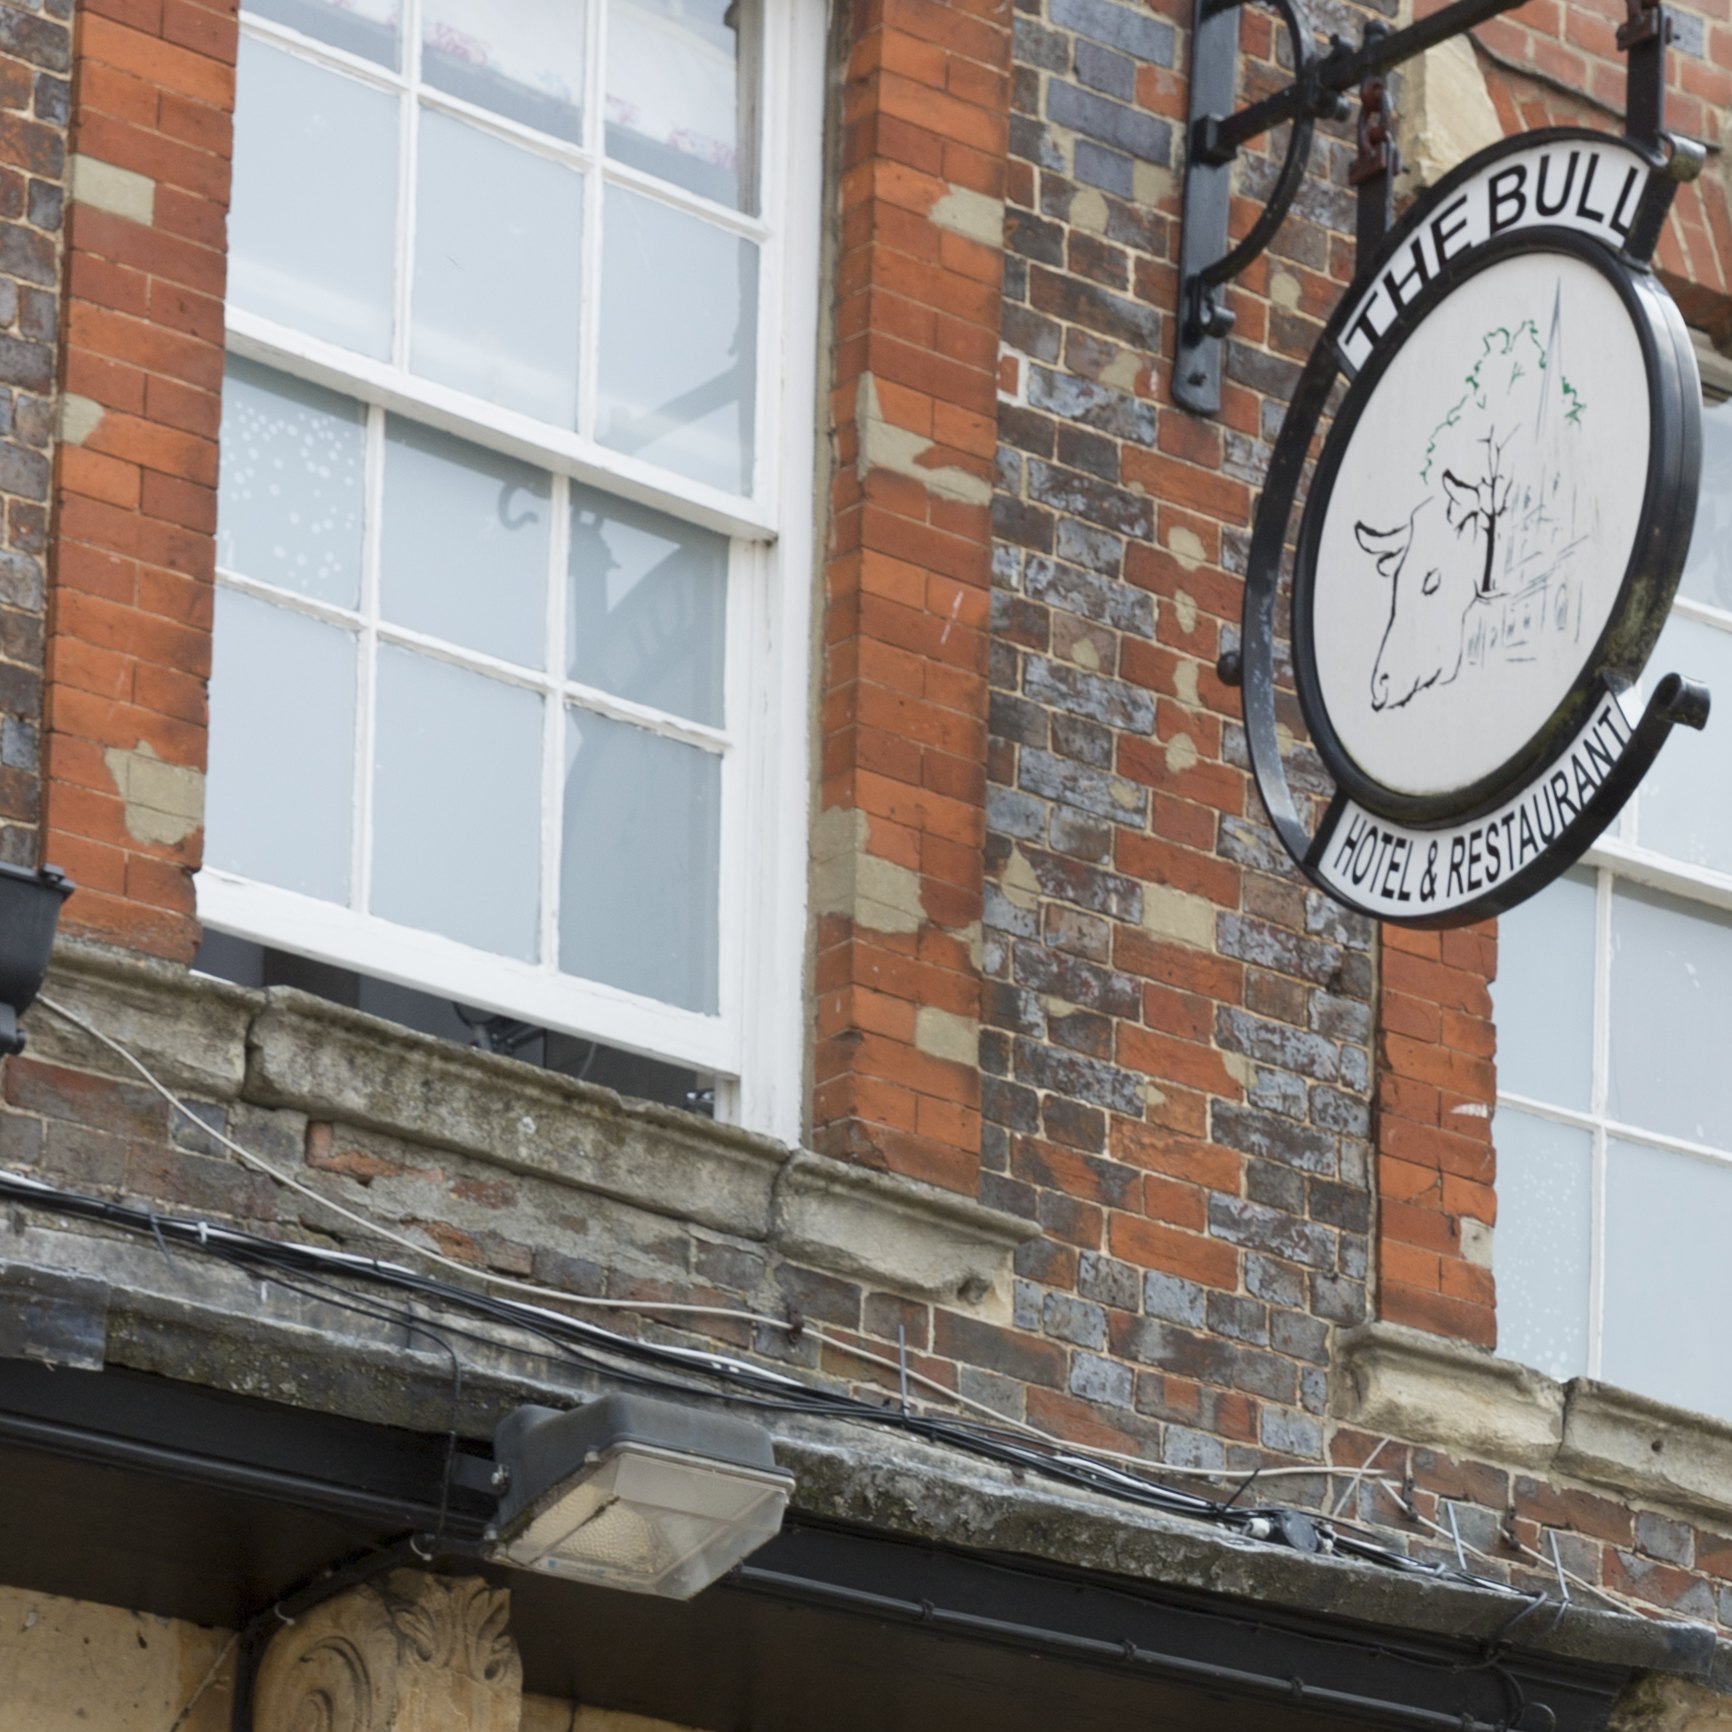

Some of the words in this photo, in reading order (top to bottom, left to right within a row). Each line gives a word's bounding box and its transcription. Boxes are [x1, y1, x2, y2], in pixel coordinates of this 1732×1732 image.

[1344, 193, 1475, 346] THE
[1487, 149, 1642, 247] BULL
[1333, 813, 1414, 901] HOTEL
[1419, 839, 1437, 902] &
[1446, 705, 1634, 898] RESTAURANT
